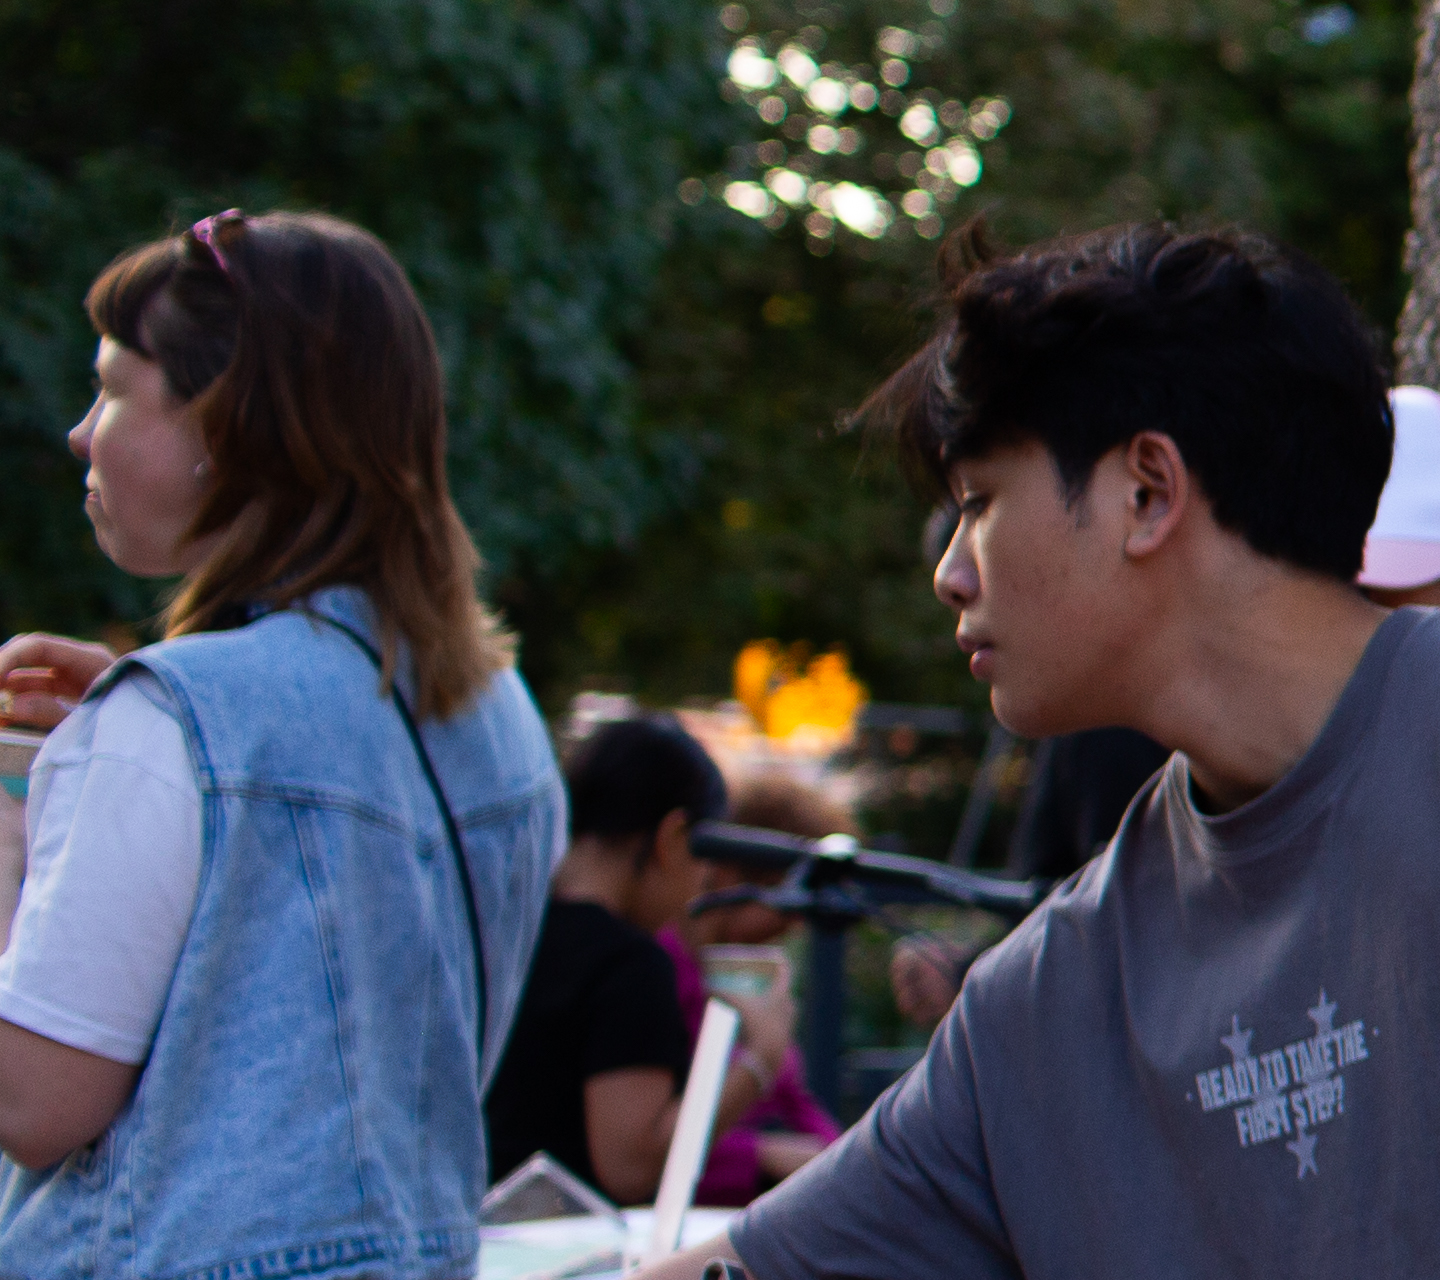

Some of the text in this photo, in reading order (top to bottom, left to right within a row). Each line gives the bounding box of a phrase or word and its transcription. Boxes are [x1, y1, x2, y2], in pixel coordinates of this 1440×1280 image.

[1195, 1020, 1370, 1113] READY TO TAKE THE
[1234, 1093, 1292, 1148] FIRST
